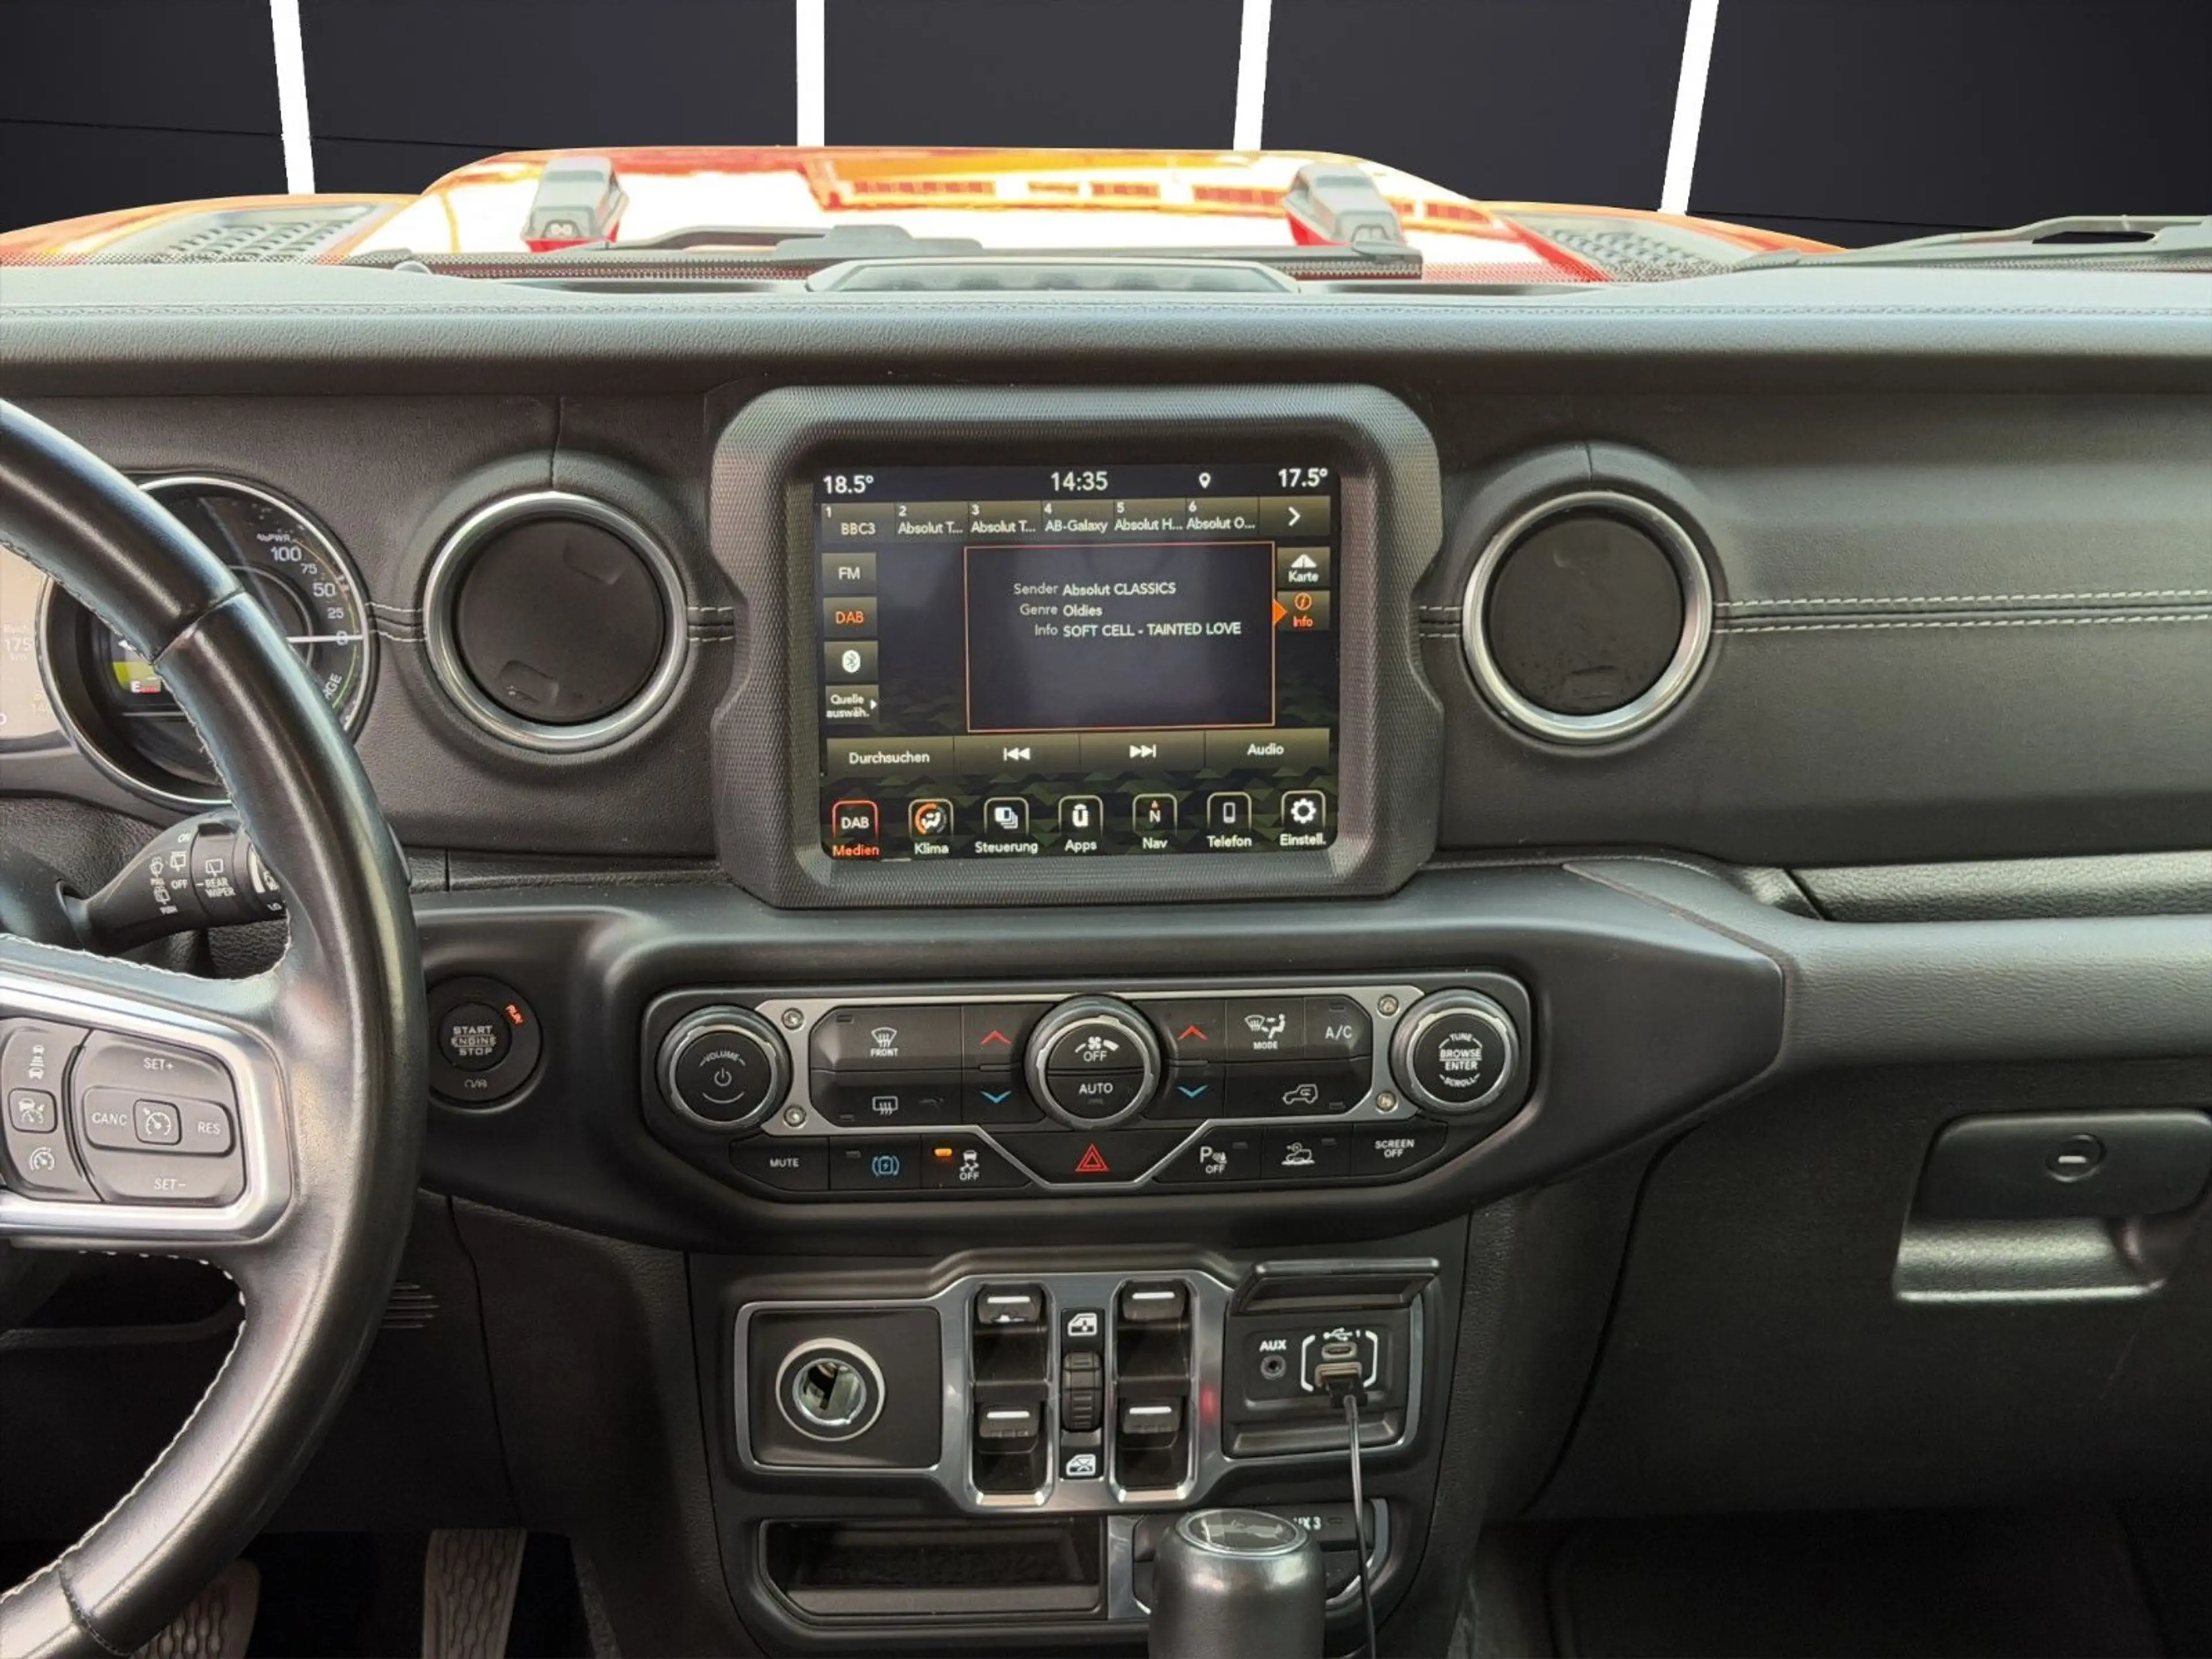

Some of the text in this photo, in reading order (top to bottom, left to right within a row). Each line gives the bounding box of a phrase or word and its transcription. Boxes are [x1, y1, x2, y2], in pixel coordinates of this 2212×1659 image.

[1051, 471, 1108, 491] 14:35
[1278, 468, 1328, 487] 17.5°
[823, 475, 874, 494] 18.5°
[825, 506, 832, 518] 1
[899, 505, 907, 517] 2
[972, 504, 980, 516] 3
[1044, 503, 1052, 514] 4
[1116, 502, 1124, 513] 5
[1188, 501, 1197, 512] 6
[841, 522, 876, 535] BBC3
[897, 521, 944, 535] Absolut
[971, 520, 1016, 533] Absolut
[1044, 520, 1108, 533] AB-Galaxy
[1114, 518, 1159, 531] Absolut
[1186, 517, 1232, 530] Absolut
[271, 547, 302, 562] 100
[300, 563, 317, 574] 75
[838, 567, 861, 580] FM
[1288, 571, 1319, 582] Karte
[313, 582, 336, 597] 50
[1013, 582, 1176, 596] Sender Absolut CLASSICS
[327, 607, 344, 619] 25
[1020, 604, 1103, 617] Genre Oldies
[835, 611, 865, 624] DAB
[1293, 616, 1313, 627] Info
[1035, 624, 1058, 636] Info
[1063, 624, 1098, 637] SOFT
[1101, 624, 1135, 637] CELL
[1146, 623, 1203, 636] TAINTED
[1206, 622, 1241, 635] LOVE
[830, 694, 864, 705] Quelle
[1247, 743, 1285, 756] Audio
[849, 751, 930, 764] Durchsuchen
[841, 816, 869, 830] DAB
[1065, 839, 1097, 852] Apps
[1143, 837, 1168, 849] Nav
[1207, 835, 1252, 848] Telefon
[1280, 833, 1326, 846] Einstell.
[833, 844, 880, 857] Medien
[915, 842, 949, 855] Klima
[975, 841, 1038, 854] Steuerung
[171, 879, 188, 890] OFF
[204, 877, 228, 888] REAR
[204, 887, 236, 898] WIPER
[453, 1025, 493, 1035] START
[1325, 1024, 1352, 1040] A/C
[451, 1036, 497, 1047] ENGINE
[1449, 1032, 1474, 1041] TUNE
[459, 1047, 493, 1056] STOP
[1253, 1041, 1278, 1050] MODE
[704, 1050, 740, 1062] VOLUME
[870, 1048, 899, 1056] FRONT
[1083, 1050, 1107, 1062] OFF
[1440, 1048, 1482, 1058] BROWSE
[1445, 1060, 1478, 1071] ENTER
[1078, 1082, 1113, 1094] AUTO
[92, 1112, 127, 1126] CANC
[198, 1121, 221, 1135] RES
[1375, 1139, 1415, 1149] SCREEN
[1384, 1148, 1404, 1158] OFF
[770, 1158, 799, 1168] MUTE
[1205, 1164, 1225, 1173] OFF
[959, 1172, 979, 1181] OFF
[1259, 1339, 1287, 1352] AUX
[1313, 1516, 1321, 1531] 3
